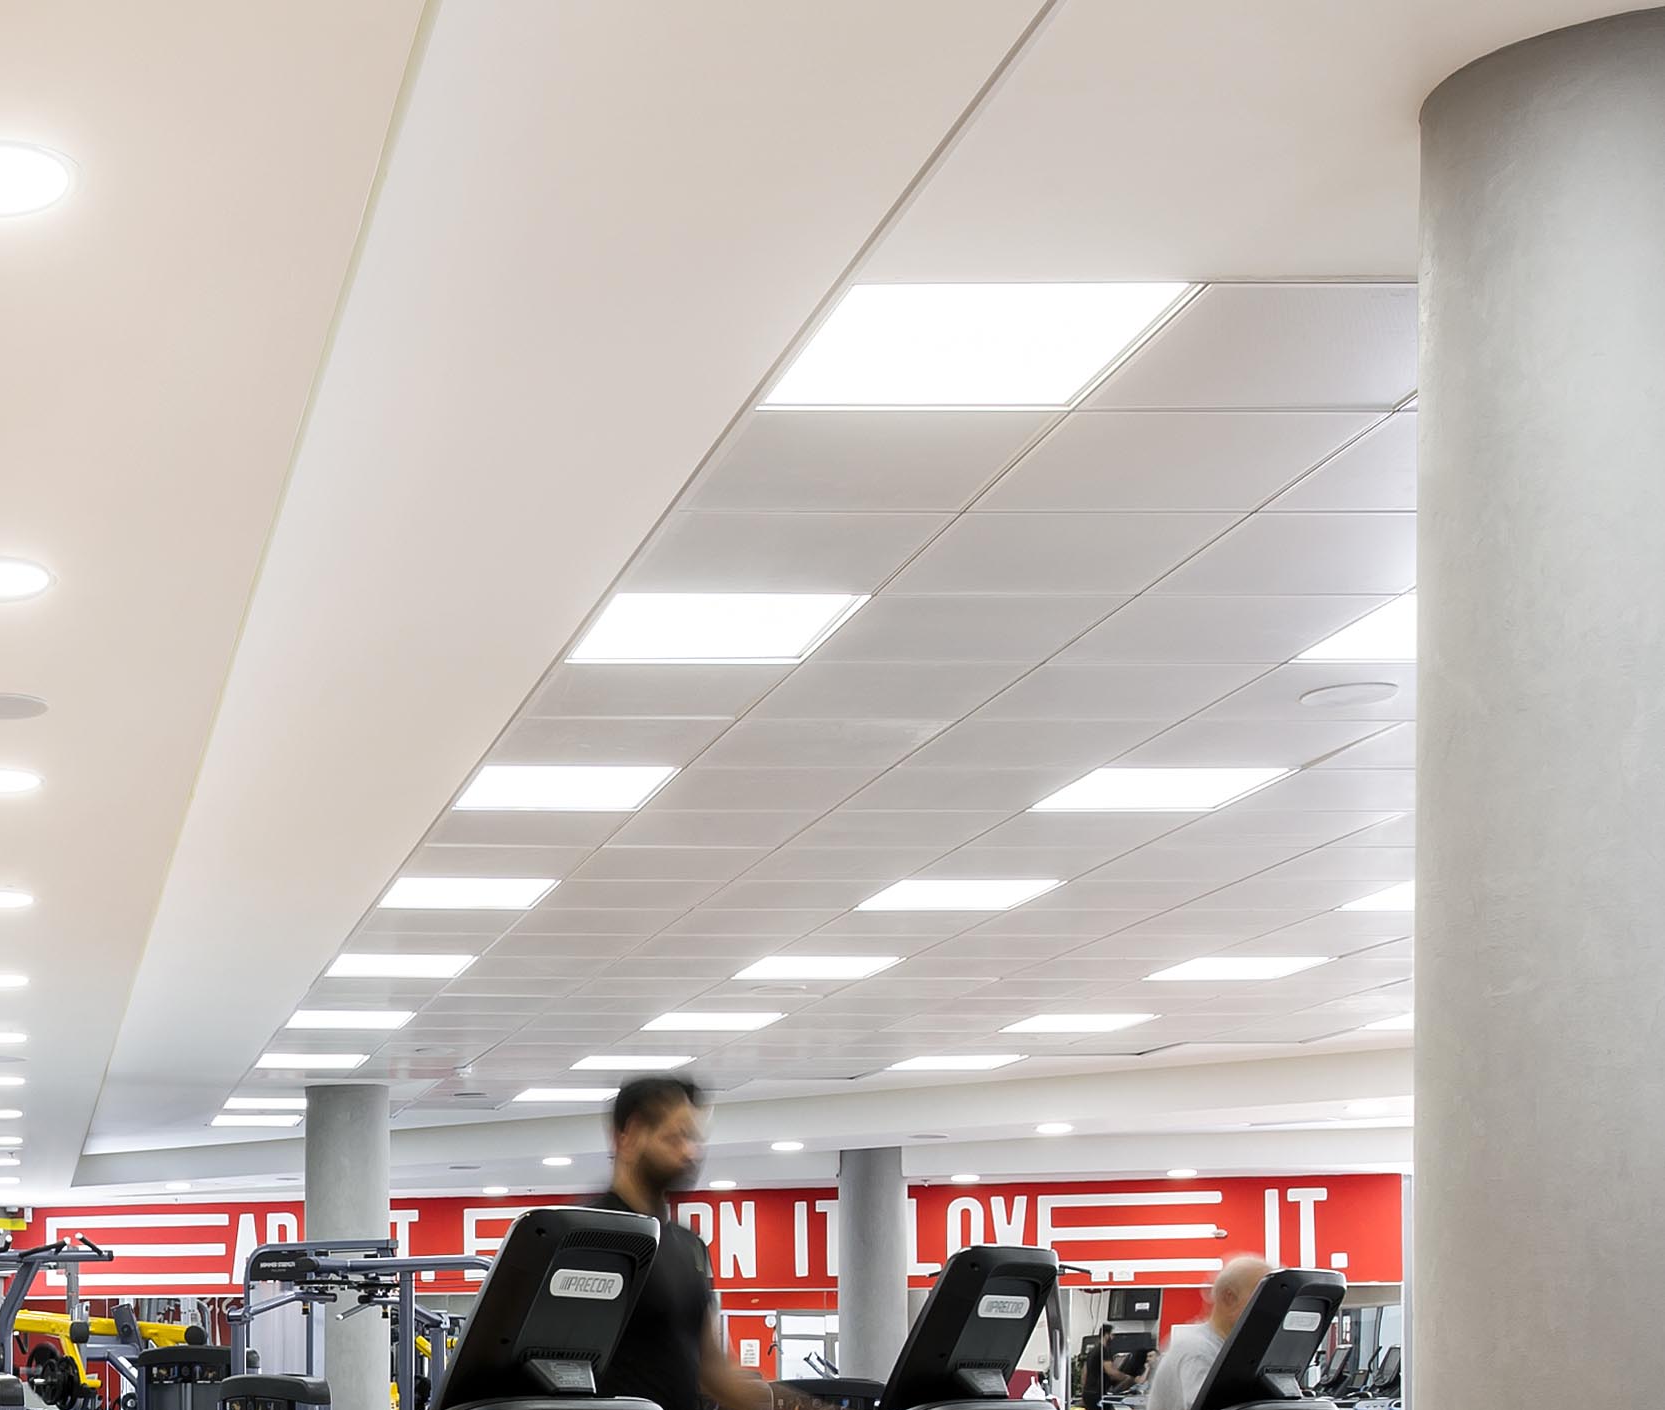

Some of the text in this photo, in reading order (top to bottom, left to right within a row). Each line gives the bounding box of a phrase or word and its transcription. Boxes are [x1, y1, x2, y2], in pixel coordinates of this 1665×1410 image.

[908, 1190, 1224, 1276] LOVE
[1264, 1187, 1348, 1270] IT.
[566, 1275, 616, 1294] PRECOR
